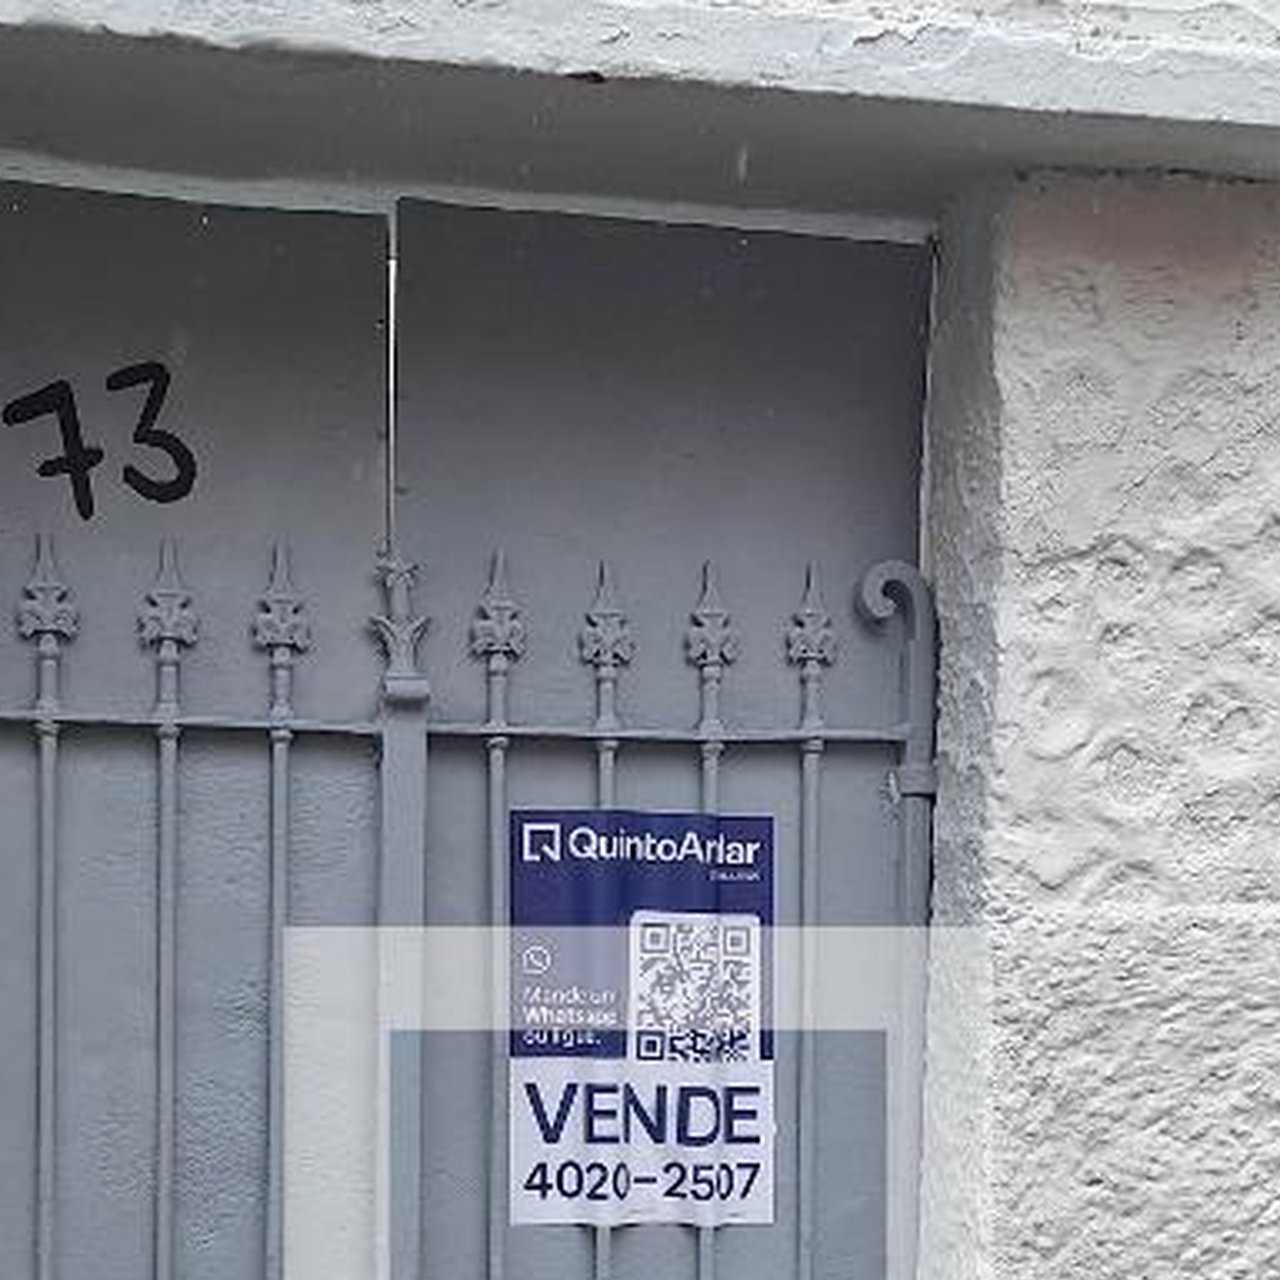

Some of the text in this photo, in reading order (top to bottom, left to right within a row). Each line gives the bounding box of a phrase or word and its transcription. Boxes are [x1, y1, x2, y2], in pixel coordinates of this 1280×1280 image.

[2, 362, 197, 520] 73
[524, 1083, 761, 1147] VENDE
[524, 1161, 761, 1201] 4020-2507
